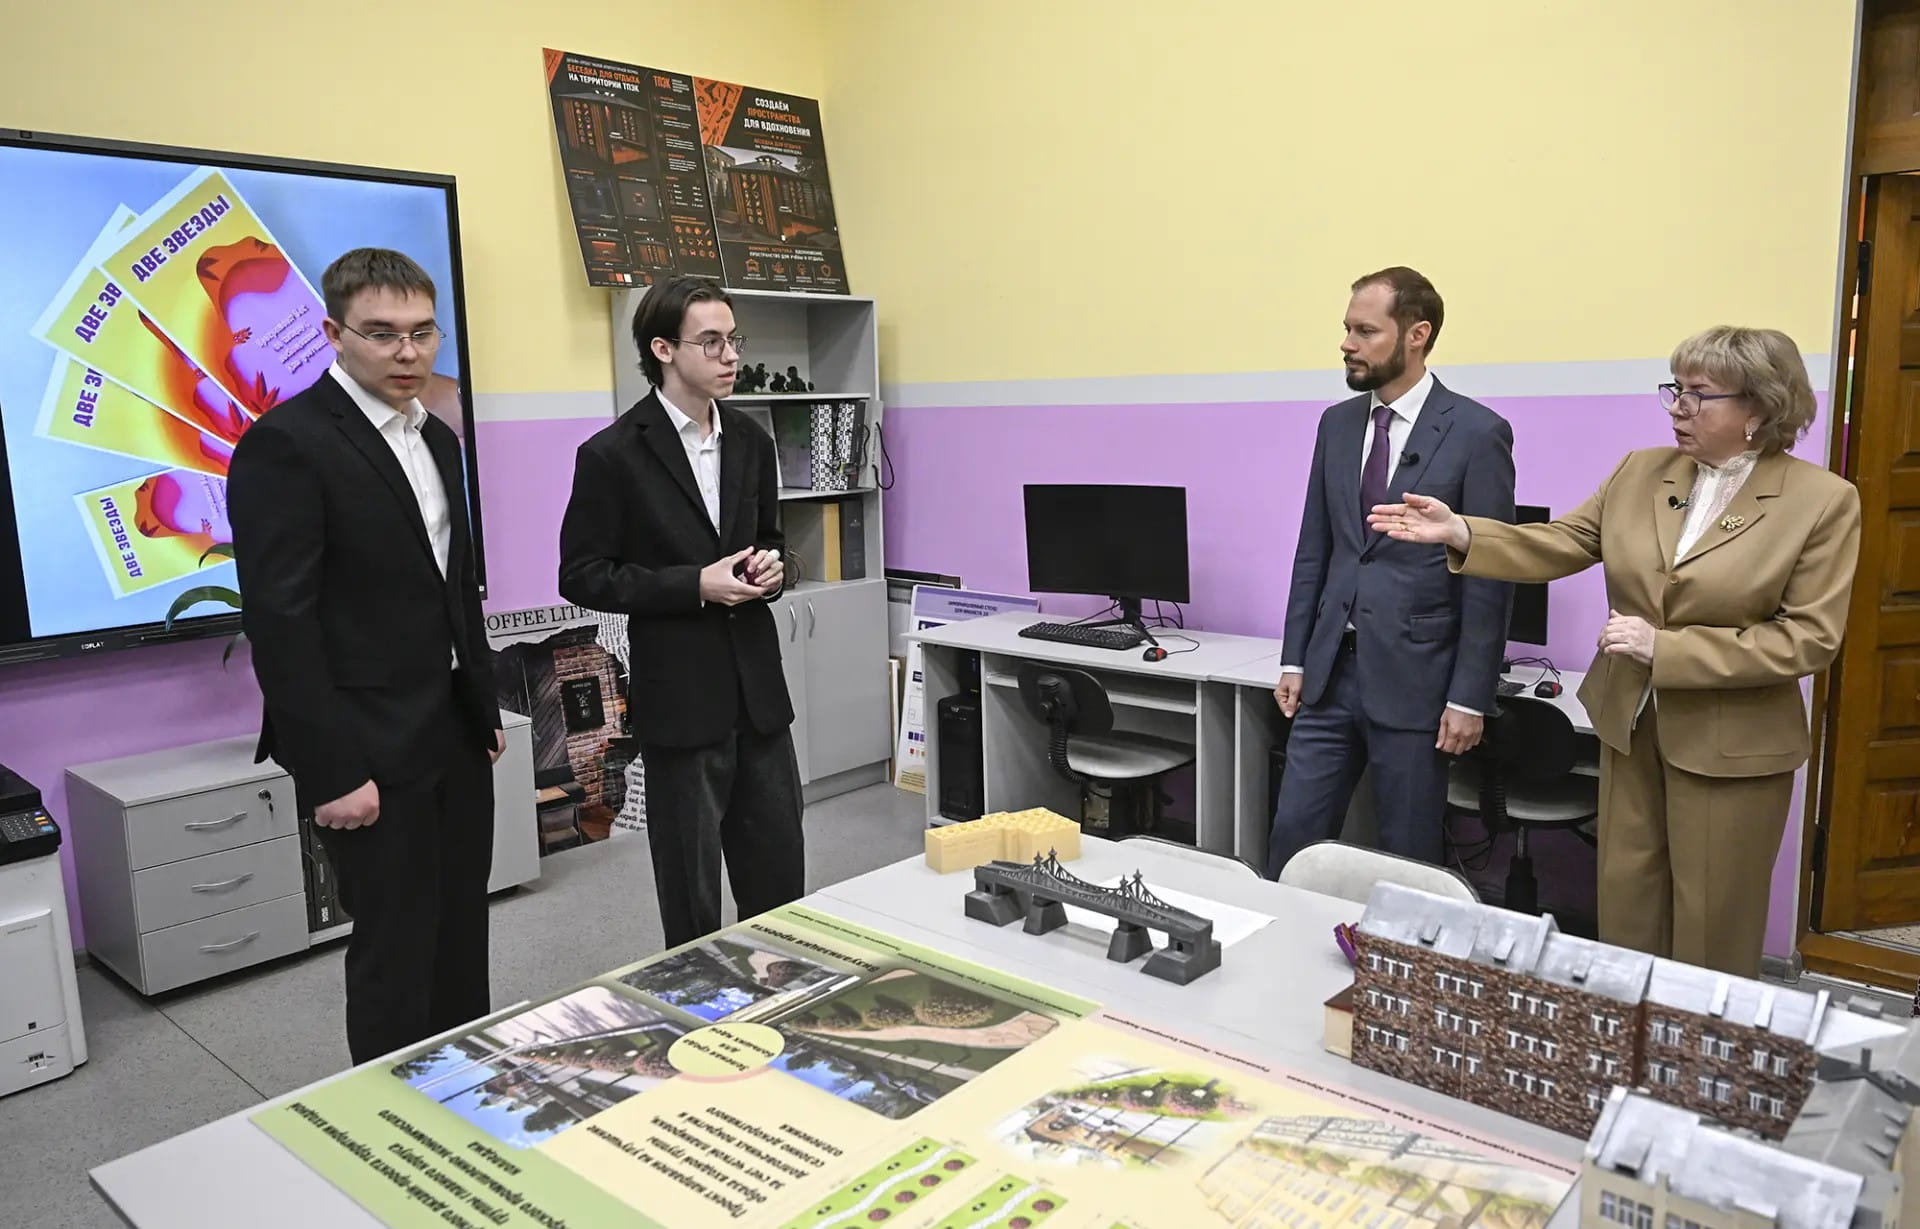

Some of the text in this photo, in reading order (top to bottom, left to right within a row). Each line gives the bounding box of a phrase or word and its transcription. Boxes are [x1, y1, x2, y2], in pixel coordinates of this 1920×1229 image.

[567, 64, 640, 84] БЕСЕДКА ДЛЯ ОТДЫХА
[568, 73, 640, 92] НА ТЕРРИТОРИИ ТПЭК
[747, 107, 801, 124] ПРОСТРАНСТВА
[755, 97, 789, 112] СОЗДАЁМ
[744, 118, 811, 137] ДЛЯ ВДОХНОВЕНИЯ
[131, 194, 230, 282] ДВЕ ЗВЕЗДЫ
[75, 304, 108, 343] ДВЕ
[72, 389, 98, 428] ДВЕ
[100, 497, 143, 578] ДВЕ ЗВЕЗДЫ
[485, 606, 592, 631] OFFEE LITE
[750, 923, 880, 973] Визуализация проекта
[682, 1037, 750, 1072] Зеленая среда
[718, 1042, 741, 1053] для
[734, 1036, 776, 1058] больших
[286, 1101, 327, 1129] входной
[322, 1125, 376, 1163] территории
[650, 1115, 786, 1190] за счет четкой планировки,
[677, 1111, 810, 1180] долговечных покрытий и
[705, 1105, 825, 1169] сезонно декоративного
[778, 1122, 844, 1158] озеленения
[378, 1109, 525, 1206] промышленно-экономического
[467, 1141, 522, 1176] колледжа
[586, 1124, 749, 1219] Проект направлен на улучшение
[647, 1135, 768, 1205] образа входной группы
[388, 1142, 510, 1226] группы главного корпуса
